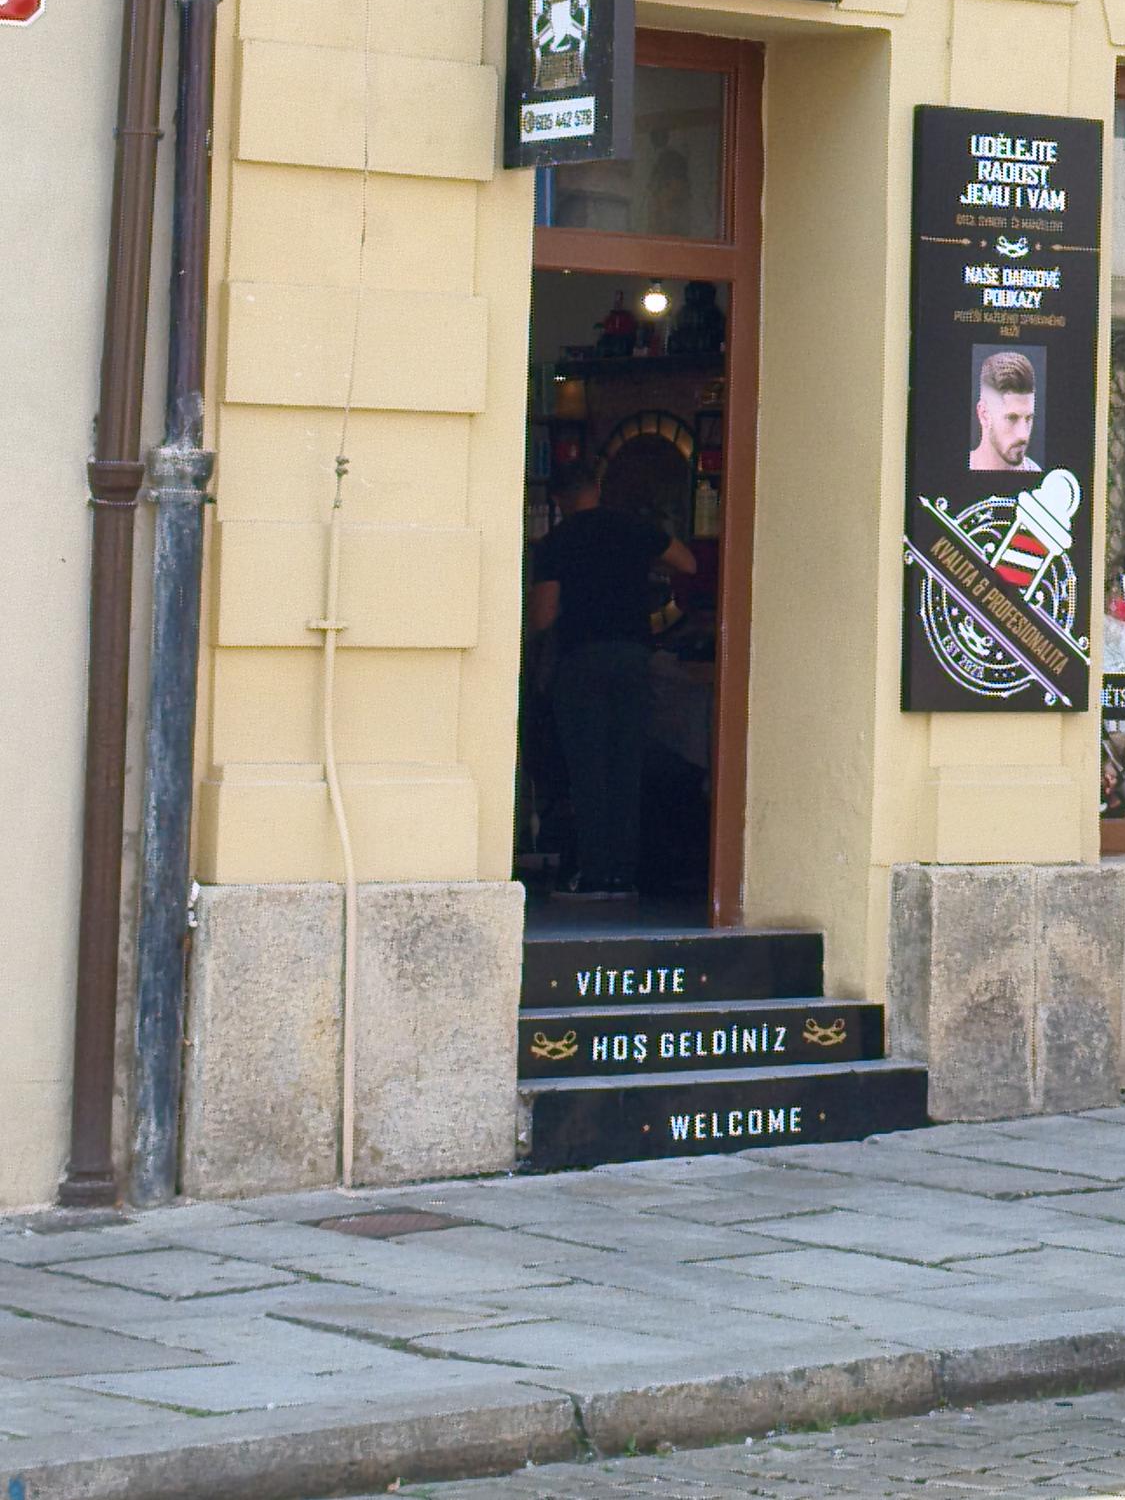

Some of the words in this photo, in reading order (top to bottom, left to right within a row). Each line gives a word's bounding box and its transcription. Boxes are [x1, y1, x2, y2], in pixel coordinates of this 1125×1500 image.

[970, 132, 1058, 163] UDĚLEJTE
[978, 160, 1050, 186] RADOST
[960, 183, 1010, 207] JEMU
[1015, 186, 1022, 208] I
[964, 263, 999, 285] NAŠE
[982, 288, 1042, 309] POUKAZY
[930, 535, 976, 588] KVALITA
[972, 580, 988, 597] &
[985, 586, 1069, 676] PROFESIONALITA
[576, 965, 686, 997] VÍTEJTE
[592, 1033, 649, 1064] HOŞ
[660, 1022, 787, 1059] GELDİNİZ
[669, 1106, 803, 1141] WELCOME
